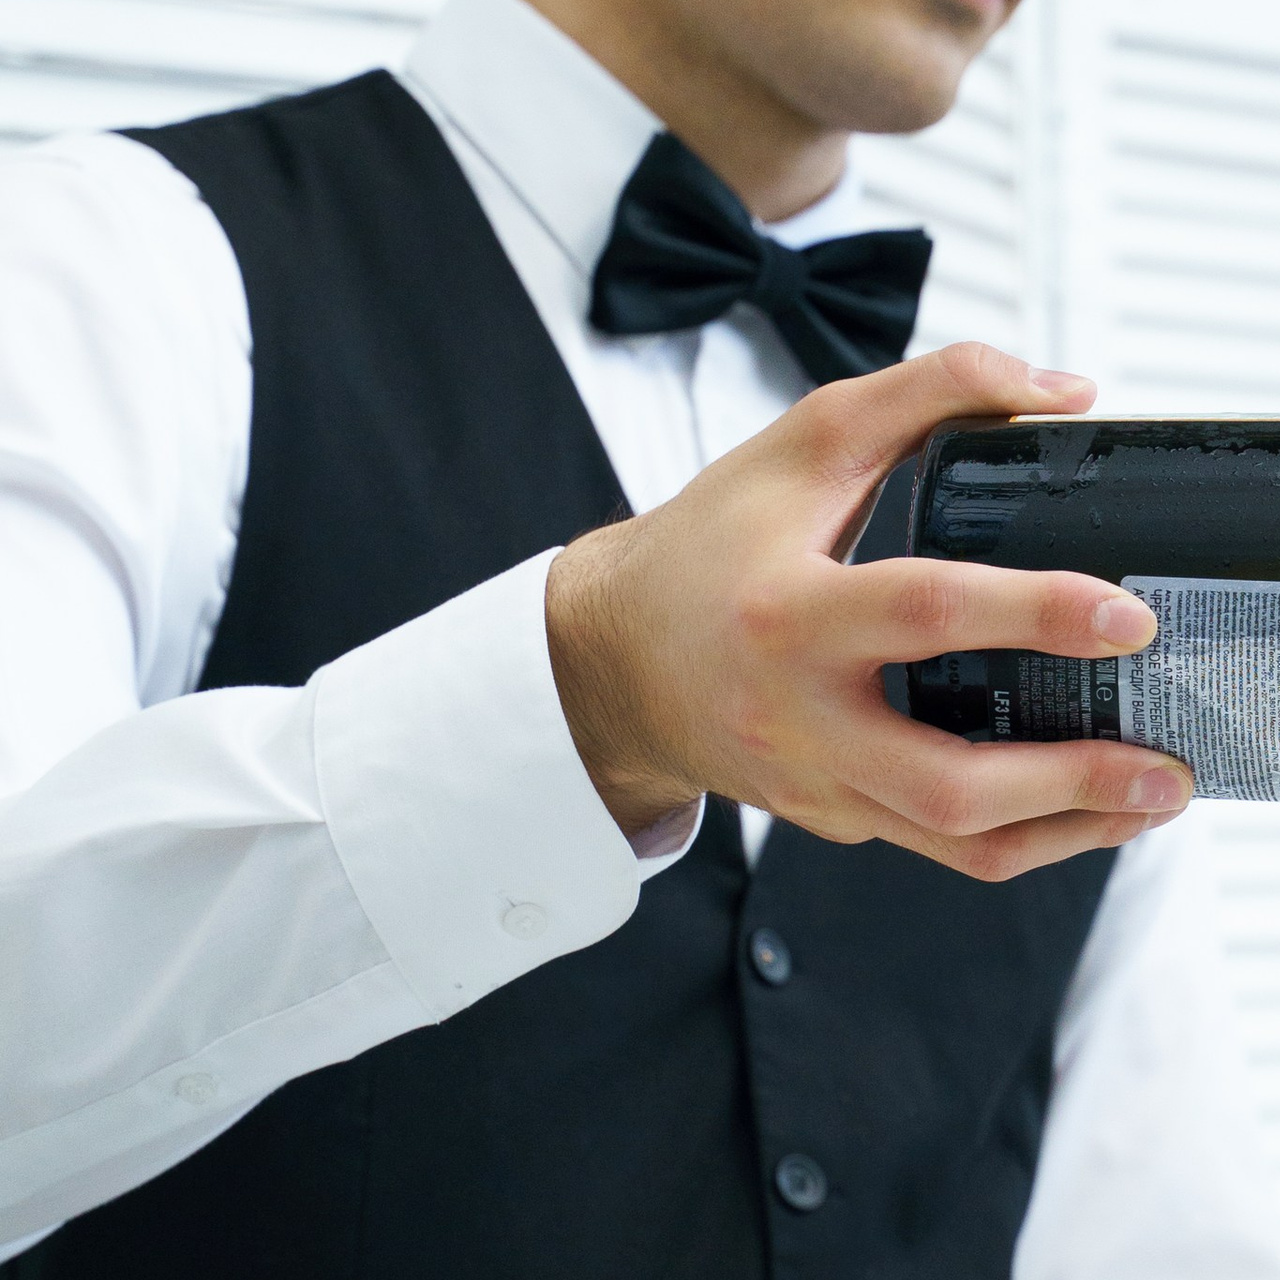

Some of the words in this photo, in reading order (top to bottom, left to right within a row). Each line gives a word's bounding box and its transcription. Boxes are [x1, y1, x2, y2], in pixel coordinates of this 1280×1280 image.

[1164, 629, 1173, 639] 12
[1018, 657, 1029, 689] OPERATE
[1031, 657, 1042, 701] BEVERAGES
[1043, 658, 1054, 668] OF
[1055, 658, 1067, 702] BEVERAGES
[1130, 654, 1144, 698] ВРЕДИТ
[1163, 667, 1172, 685] 0,75
[1043, 671, 1054, 693] BIRTH
[1080, 659, 1091, 712] GOVERNMENT
[1132, 700, 1146, 742] ВАШЕМУ
